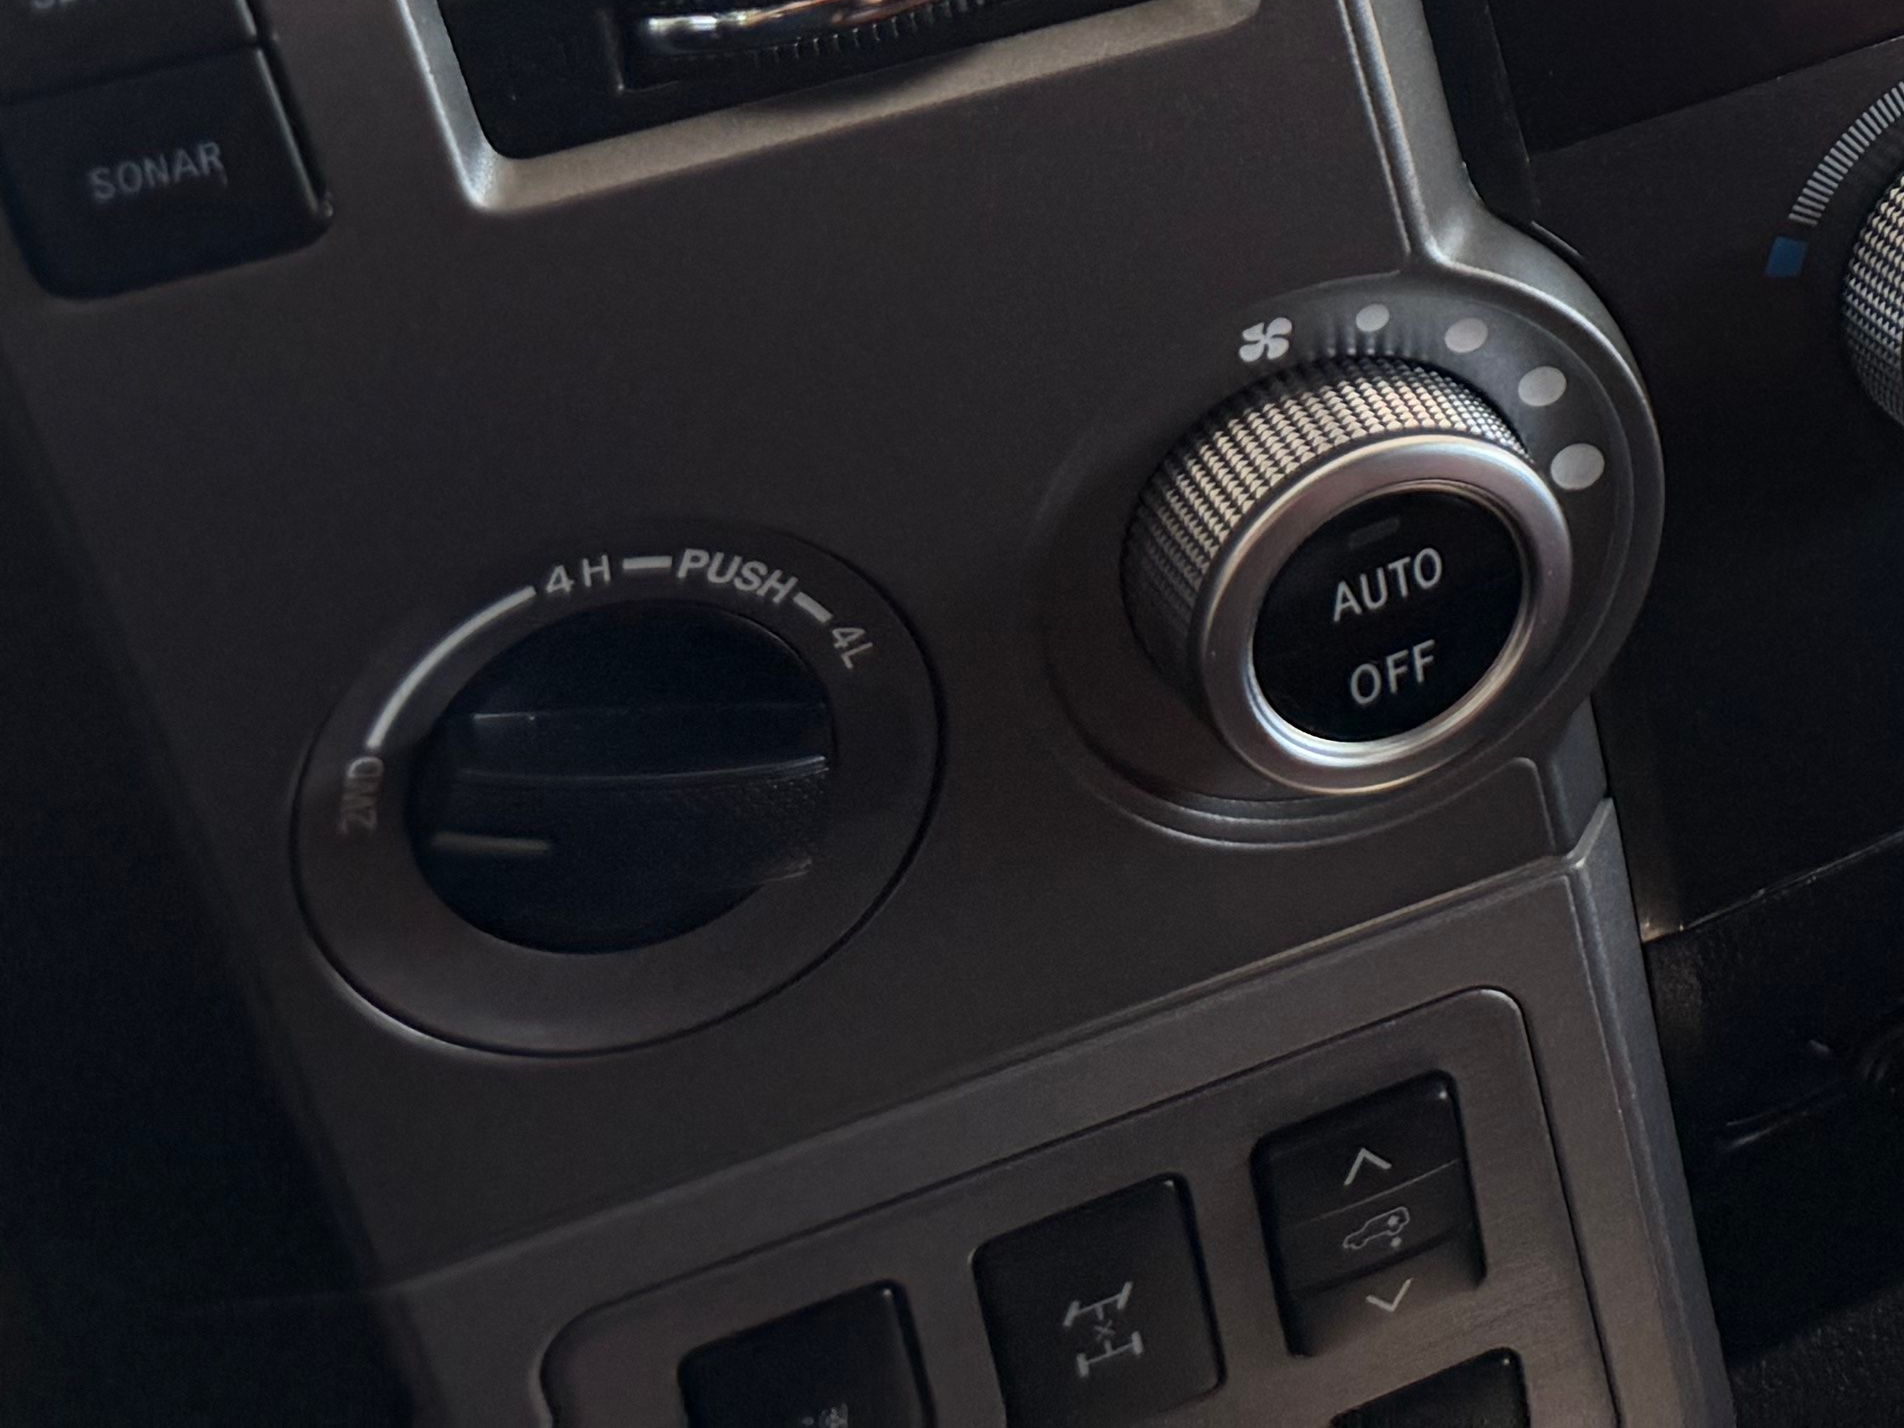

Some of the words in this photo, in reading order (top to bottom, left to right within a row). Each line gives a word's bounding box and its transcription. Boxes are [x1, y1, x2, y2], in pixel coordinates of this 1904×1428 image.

[88, 140, 224, 203] SONAR
[545, 553, 612, 596] 4H
[676, 547, 799, 605] PUSH
[829, 621, 874, 670] 4L
[1332, 546, 1443, 622] AUTO
[1349, 638, 1436, 707] OFF
